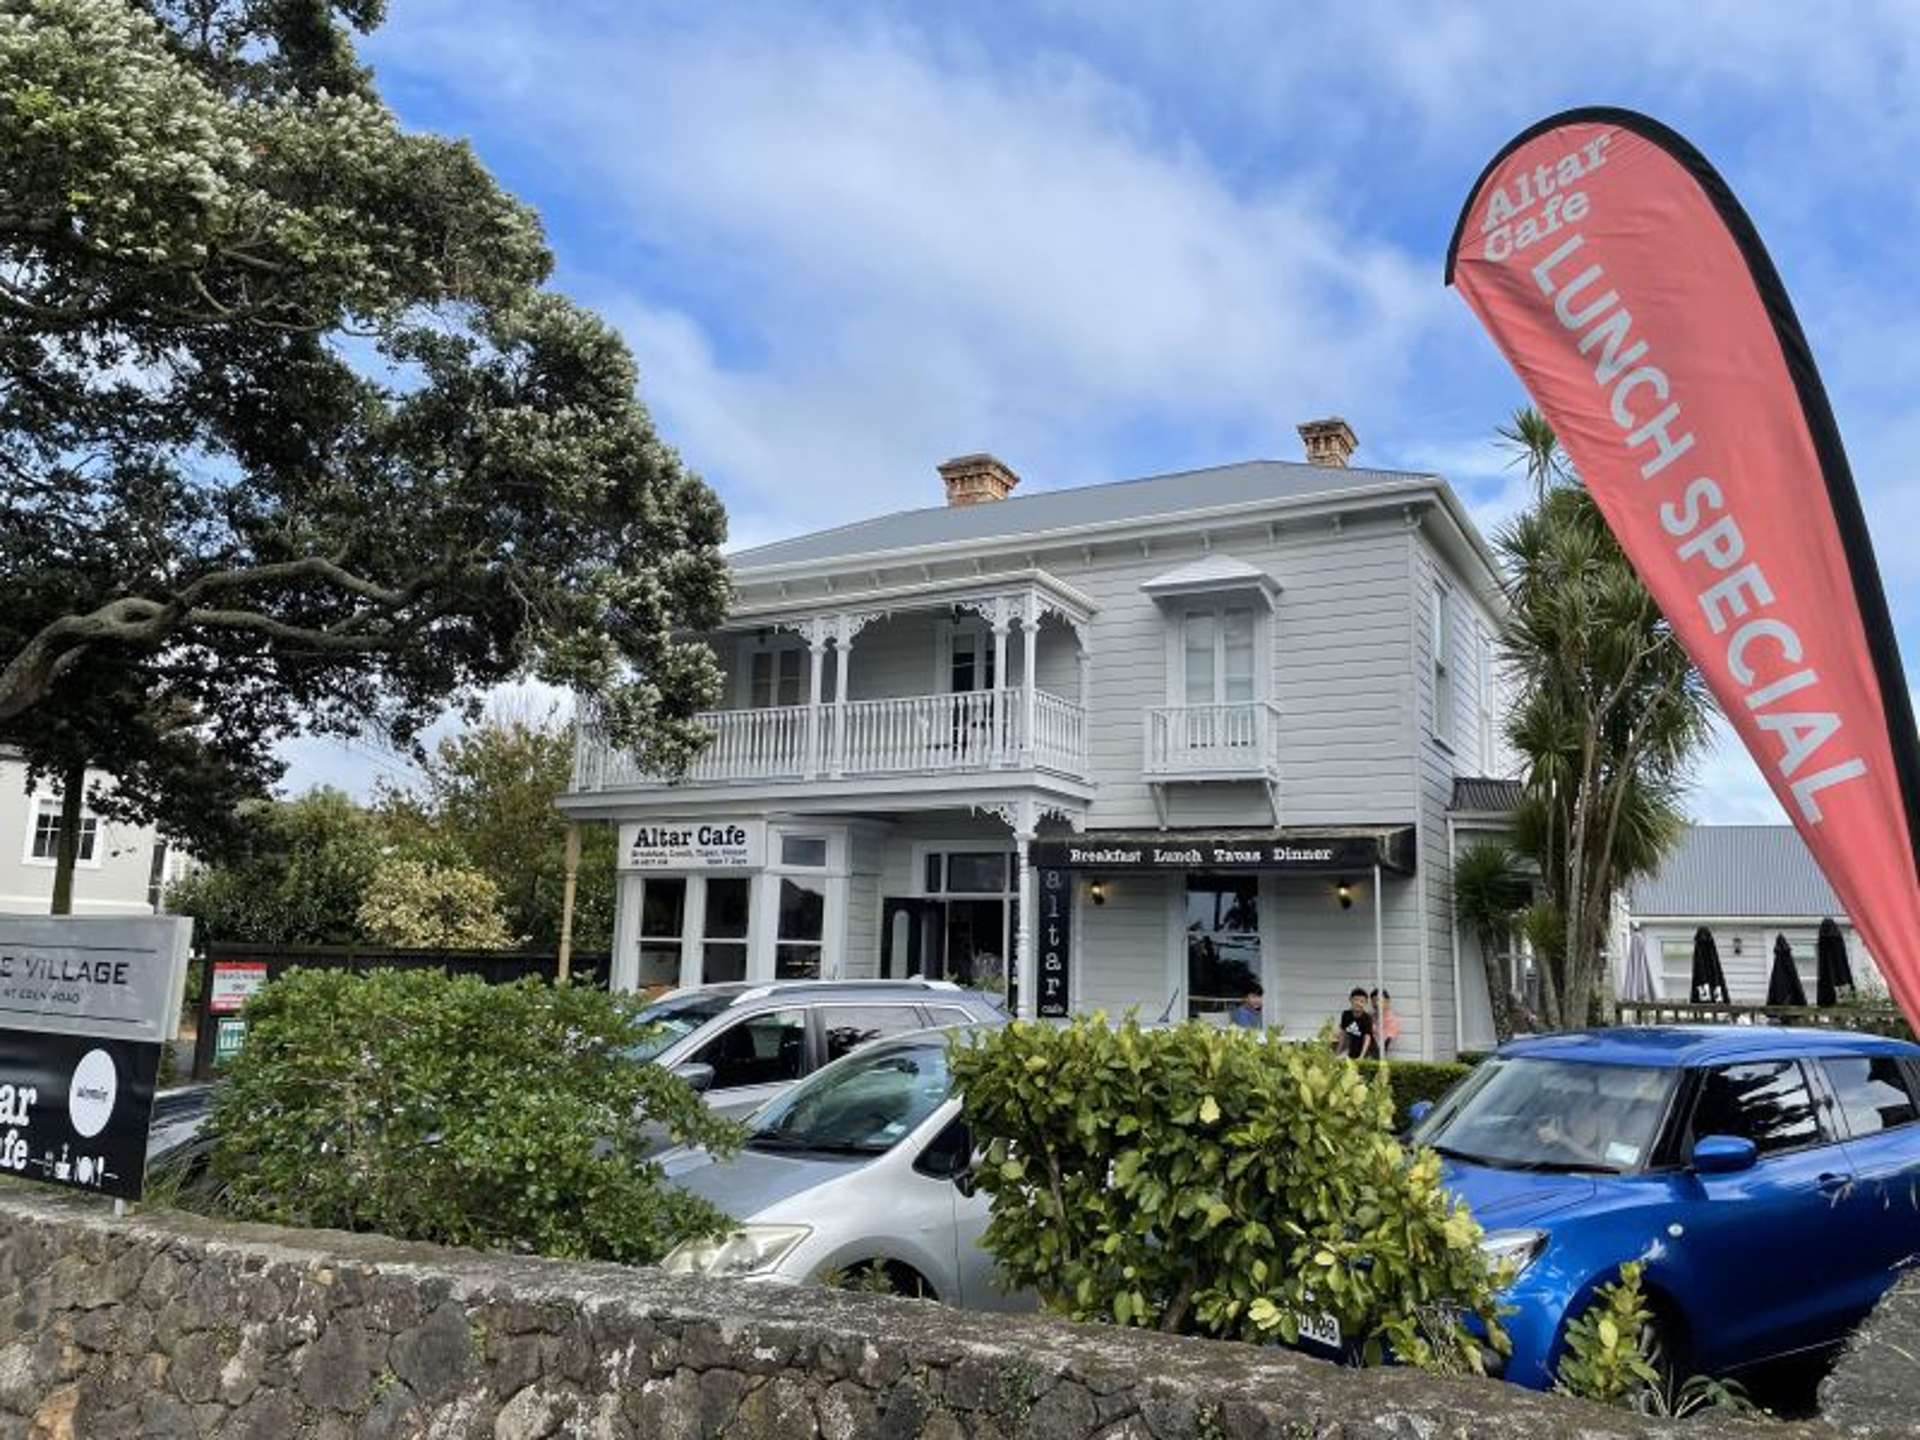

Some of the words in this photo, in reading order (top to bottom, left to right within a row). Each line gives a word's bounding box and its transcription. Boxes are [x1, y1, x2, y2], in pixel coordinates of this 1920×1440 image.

[1481, 134, 1612, 234] Altar
[1485, 191, 1589, 262] Cafe
[1532, 234, 1695, 480] LUNCH
[1661, 476, 1868, 826] SPECIAL
[633, 827, 692, 848] Altar
[698, 825, 746, 846] Cafe
[1070, 848, 1141, 862] Breakfast
[1153, 848, 1203, 863] Lunch
[1273, 846, 1333, 860] Dinner
[1045, 870, 1062, 996] altar
[24, 958, 129, 985] VILLAGE
